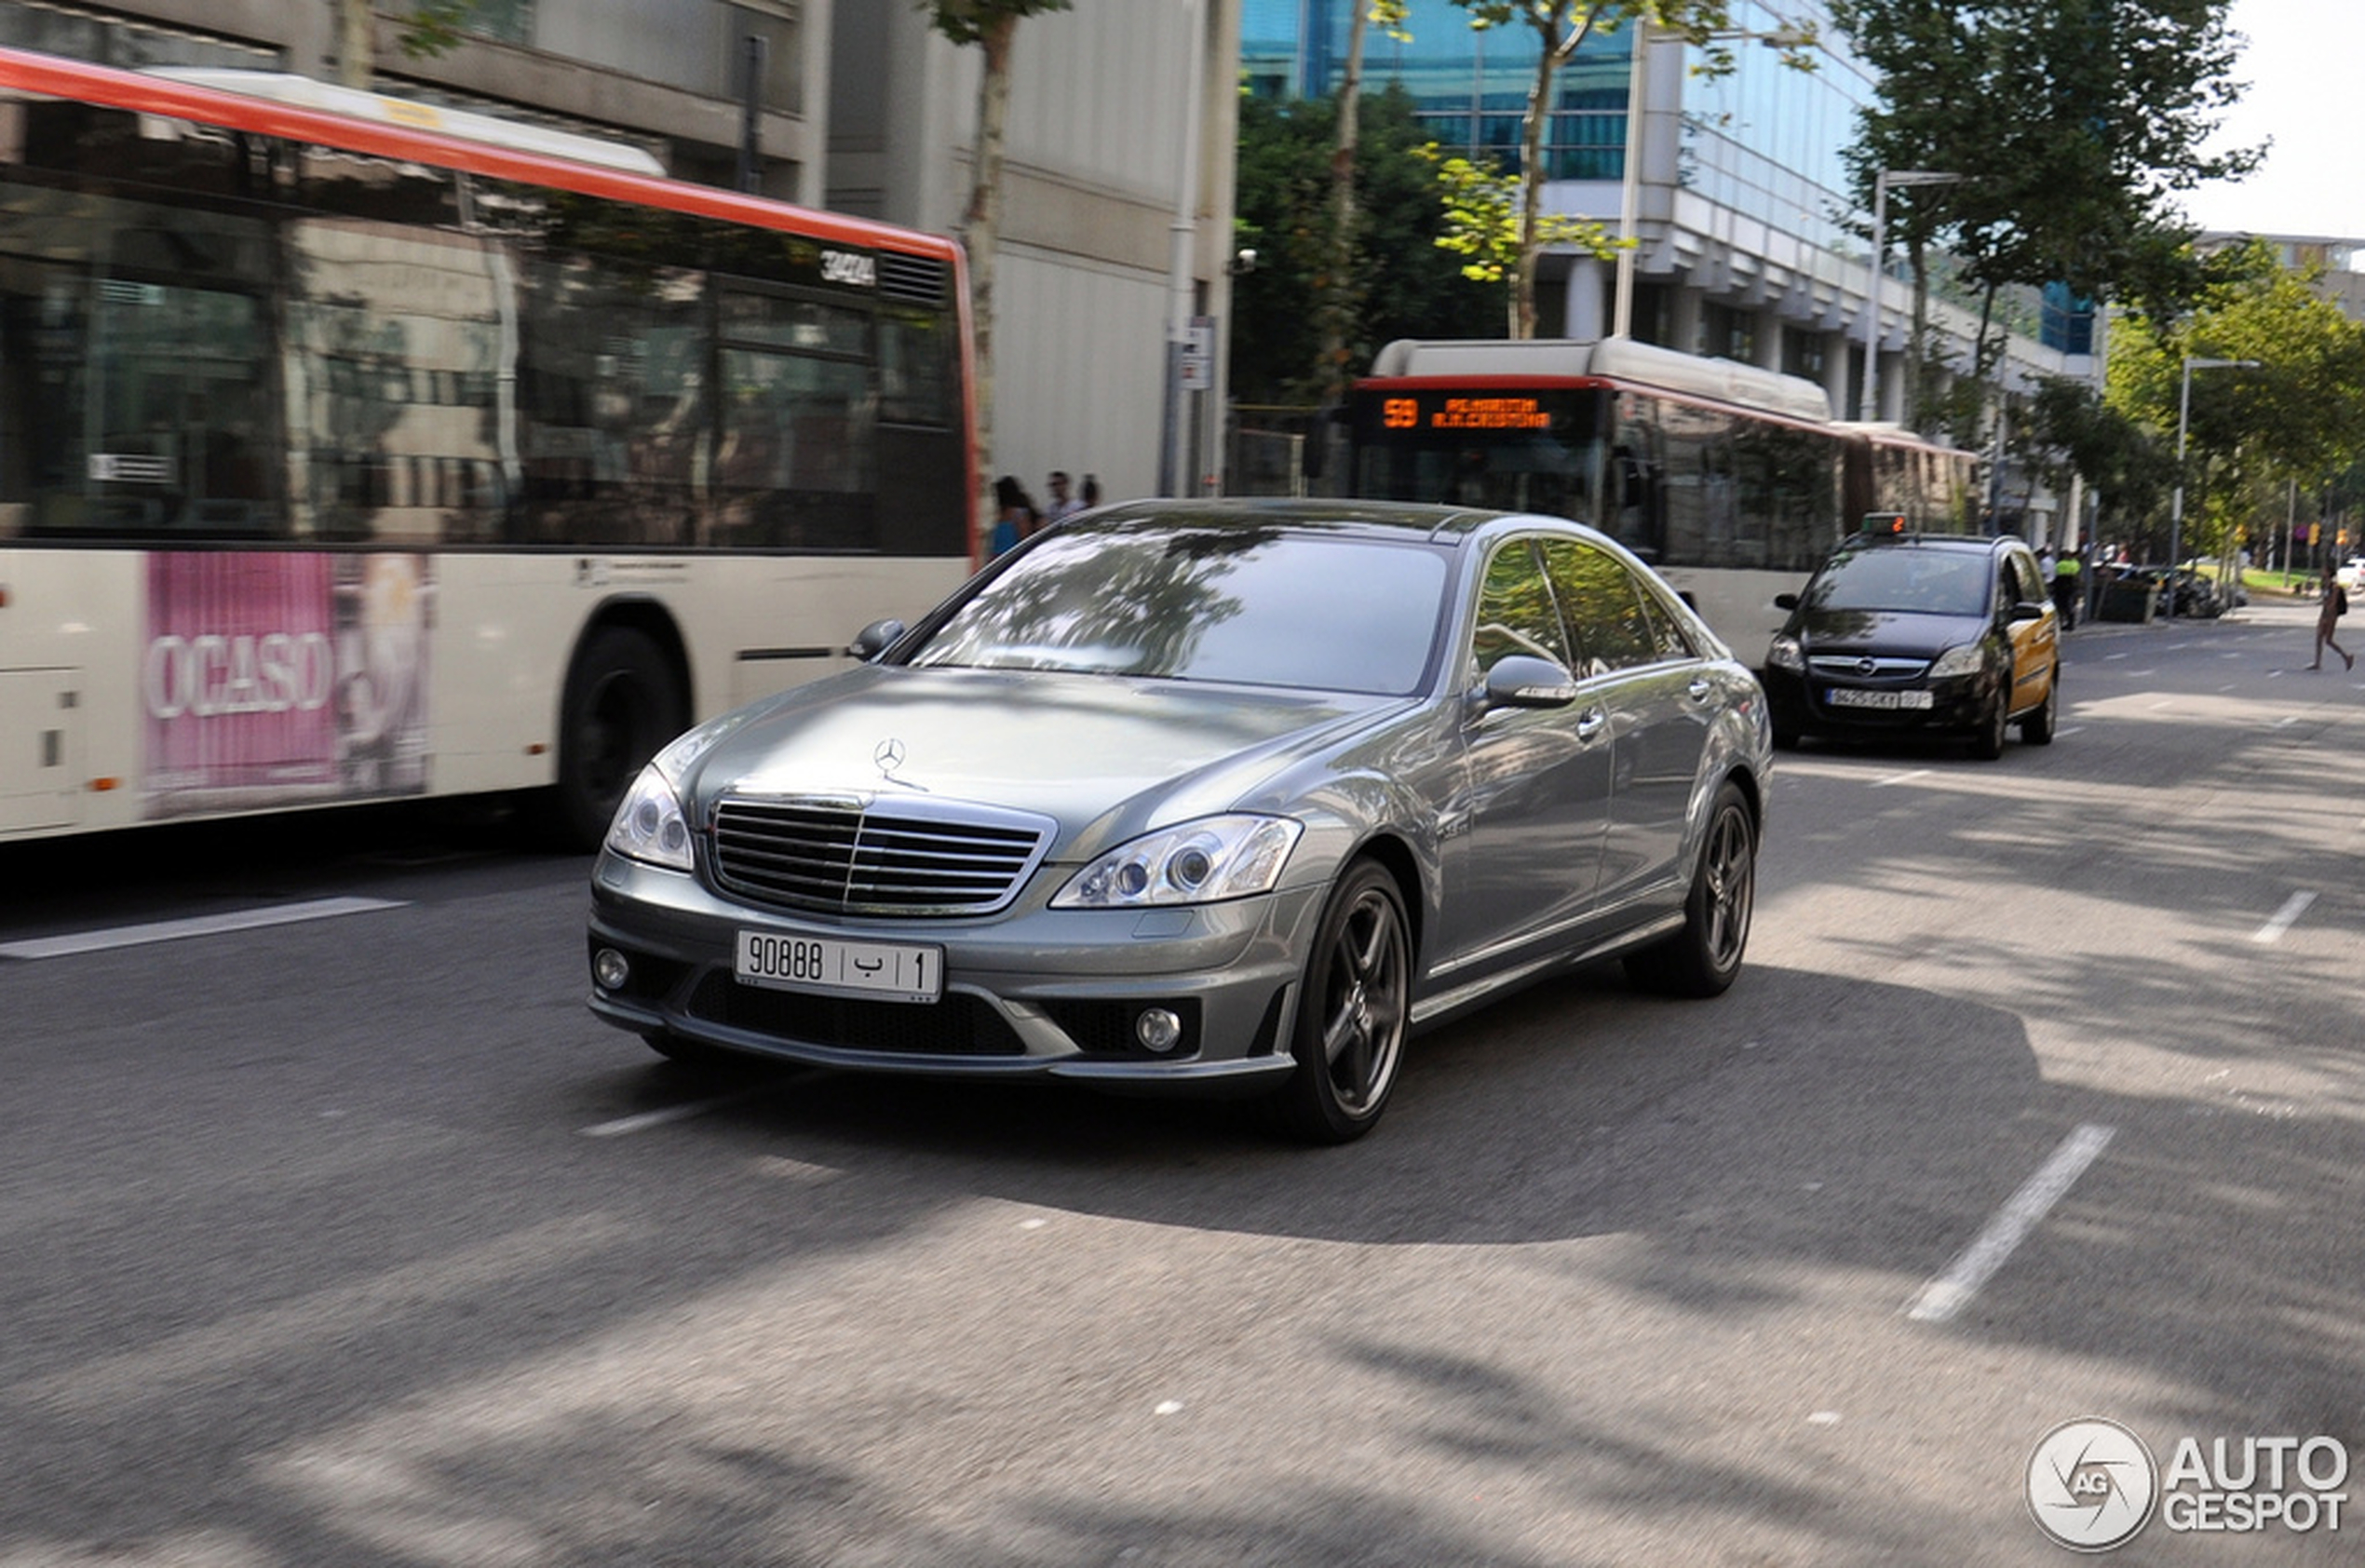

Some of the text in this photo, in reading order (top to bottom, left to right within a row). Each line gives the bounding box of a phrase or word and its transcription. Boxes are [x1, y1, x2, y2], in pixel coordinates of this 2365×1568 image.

[1384, 398, 1418, 427] 59
[147, 632, 332, 719] OCASO
[750, 937, 924, 990] 90888 ب 1
